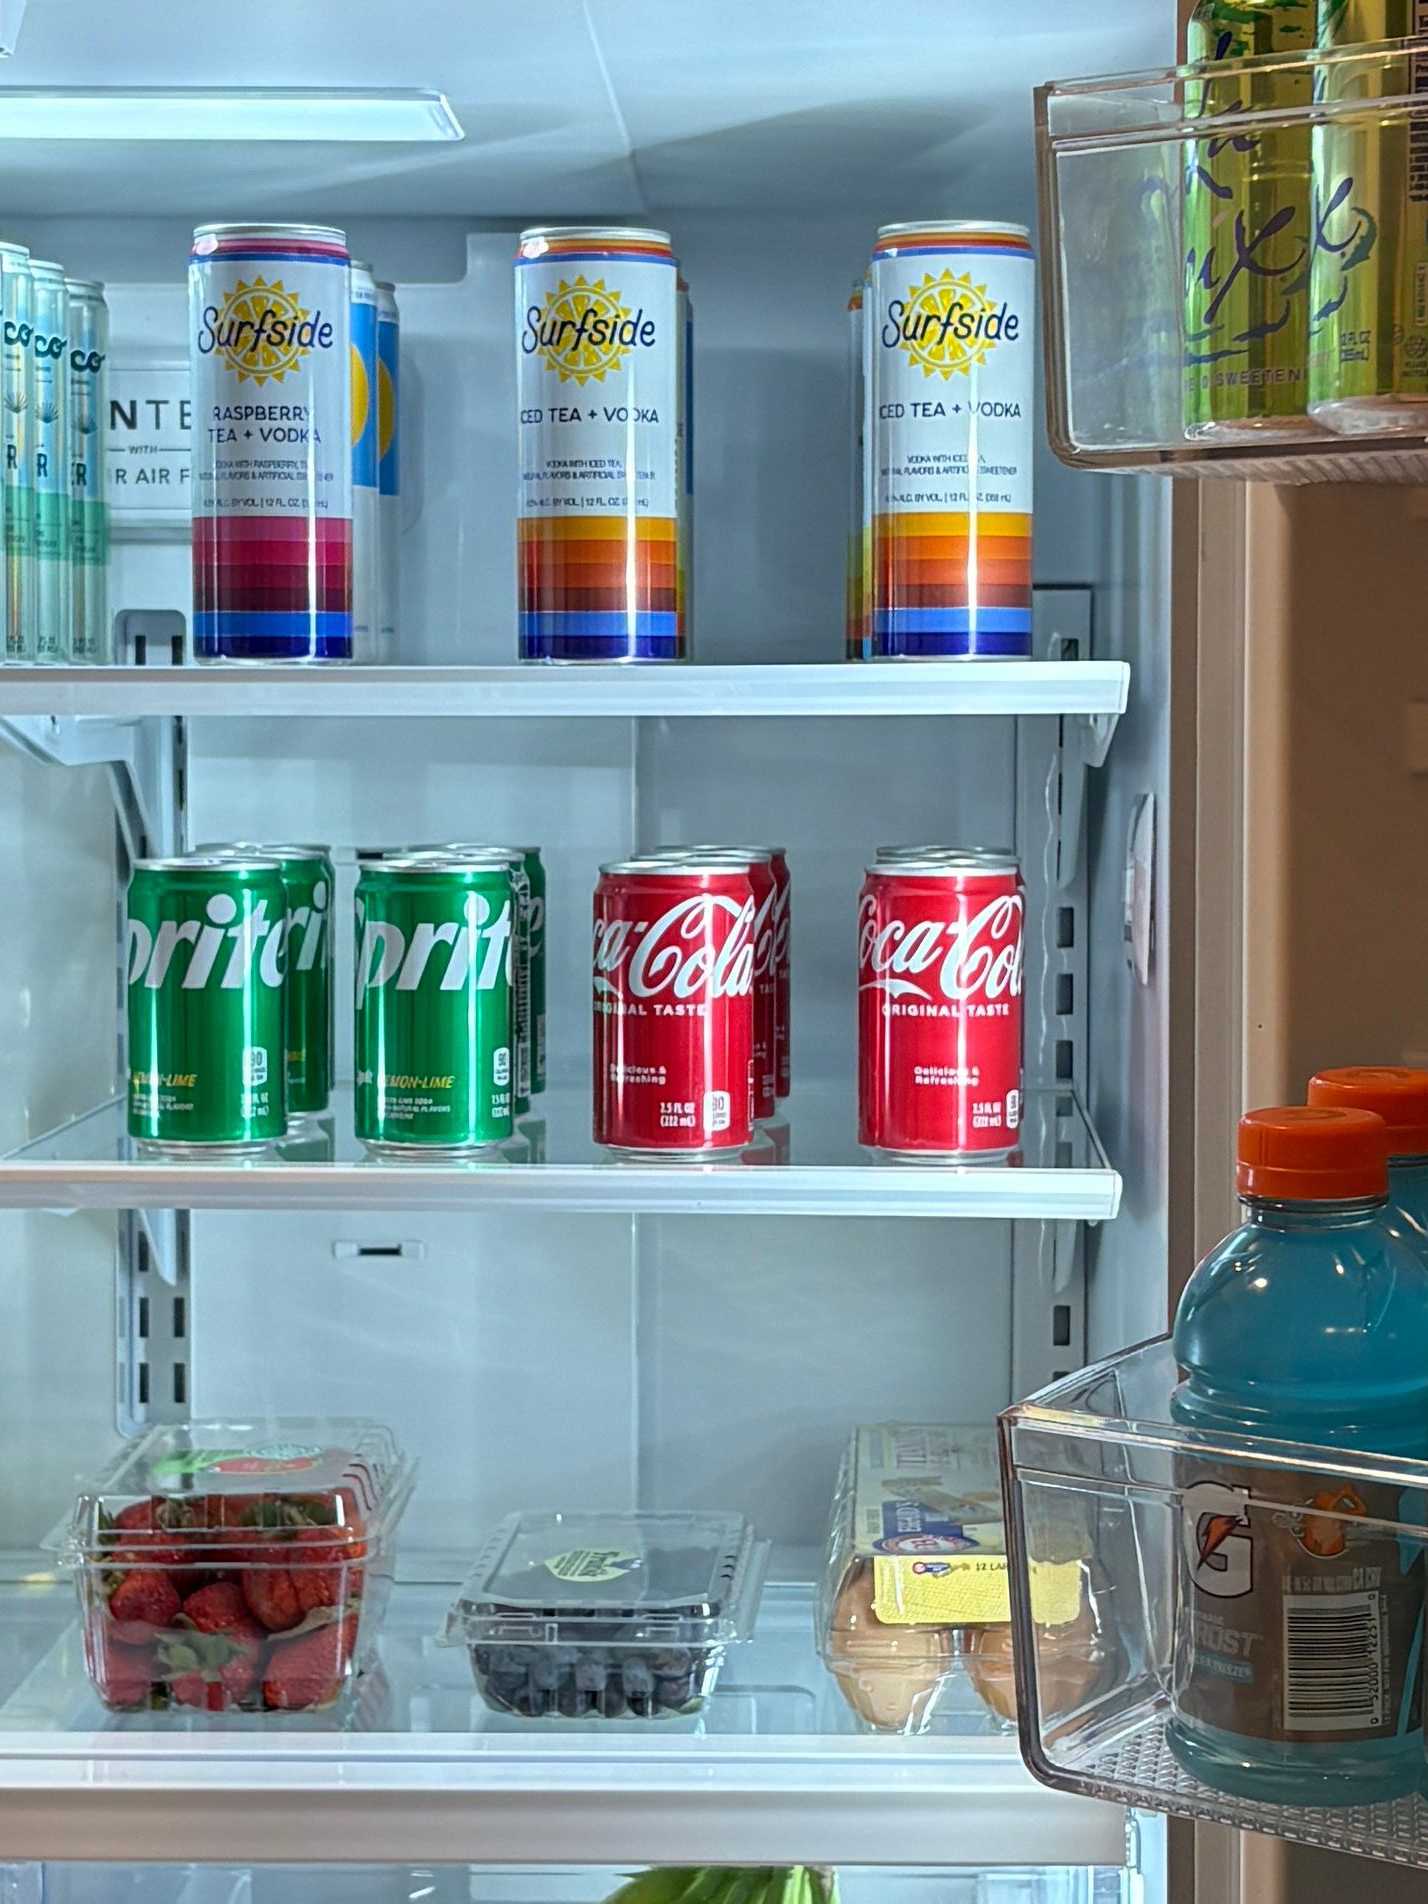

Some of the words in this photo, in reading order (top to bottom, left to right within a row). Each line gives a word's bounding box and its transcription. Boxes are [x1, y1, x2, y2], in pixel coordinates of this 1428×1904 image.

[197, 304, 335, 356] Surfside
[521, 304, 656, 355] Surfside
[882, 299, 1020, 349] Surfside
[213, 405, 311, 422] RASPBERRY
[548, 407, 582, 424] TEA
[603, 407, 659, 424] VODKA
[910, 402, 946, 418] TEA
[968, 401, 1022, 418] VODKA
[208, 428, 239, 444] TEA
[260, 427, 322, 444] VODKA
[129, 445, 158, 455] WITH
[136, 468, 171, 486] AIR
[653, 1003, 709, 1017] TASTE
[882, 1003, 959, 1017] ORIGINAL
[966, 1003, 1009, 1017] TASTE
